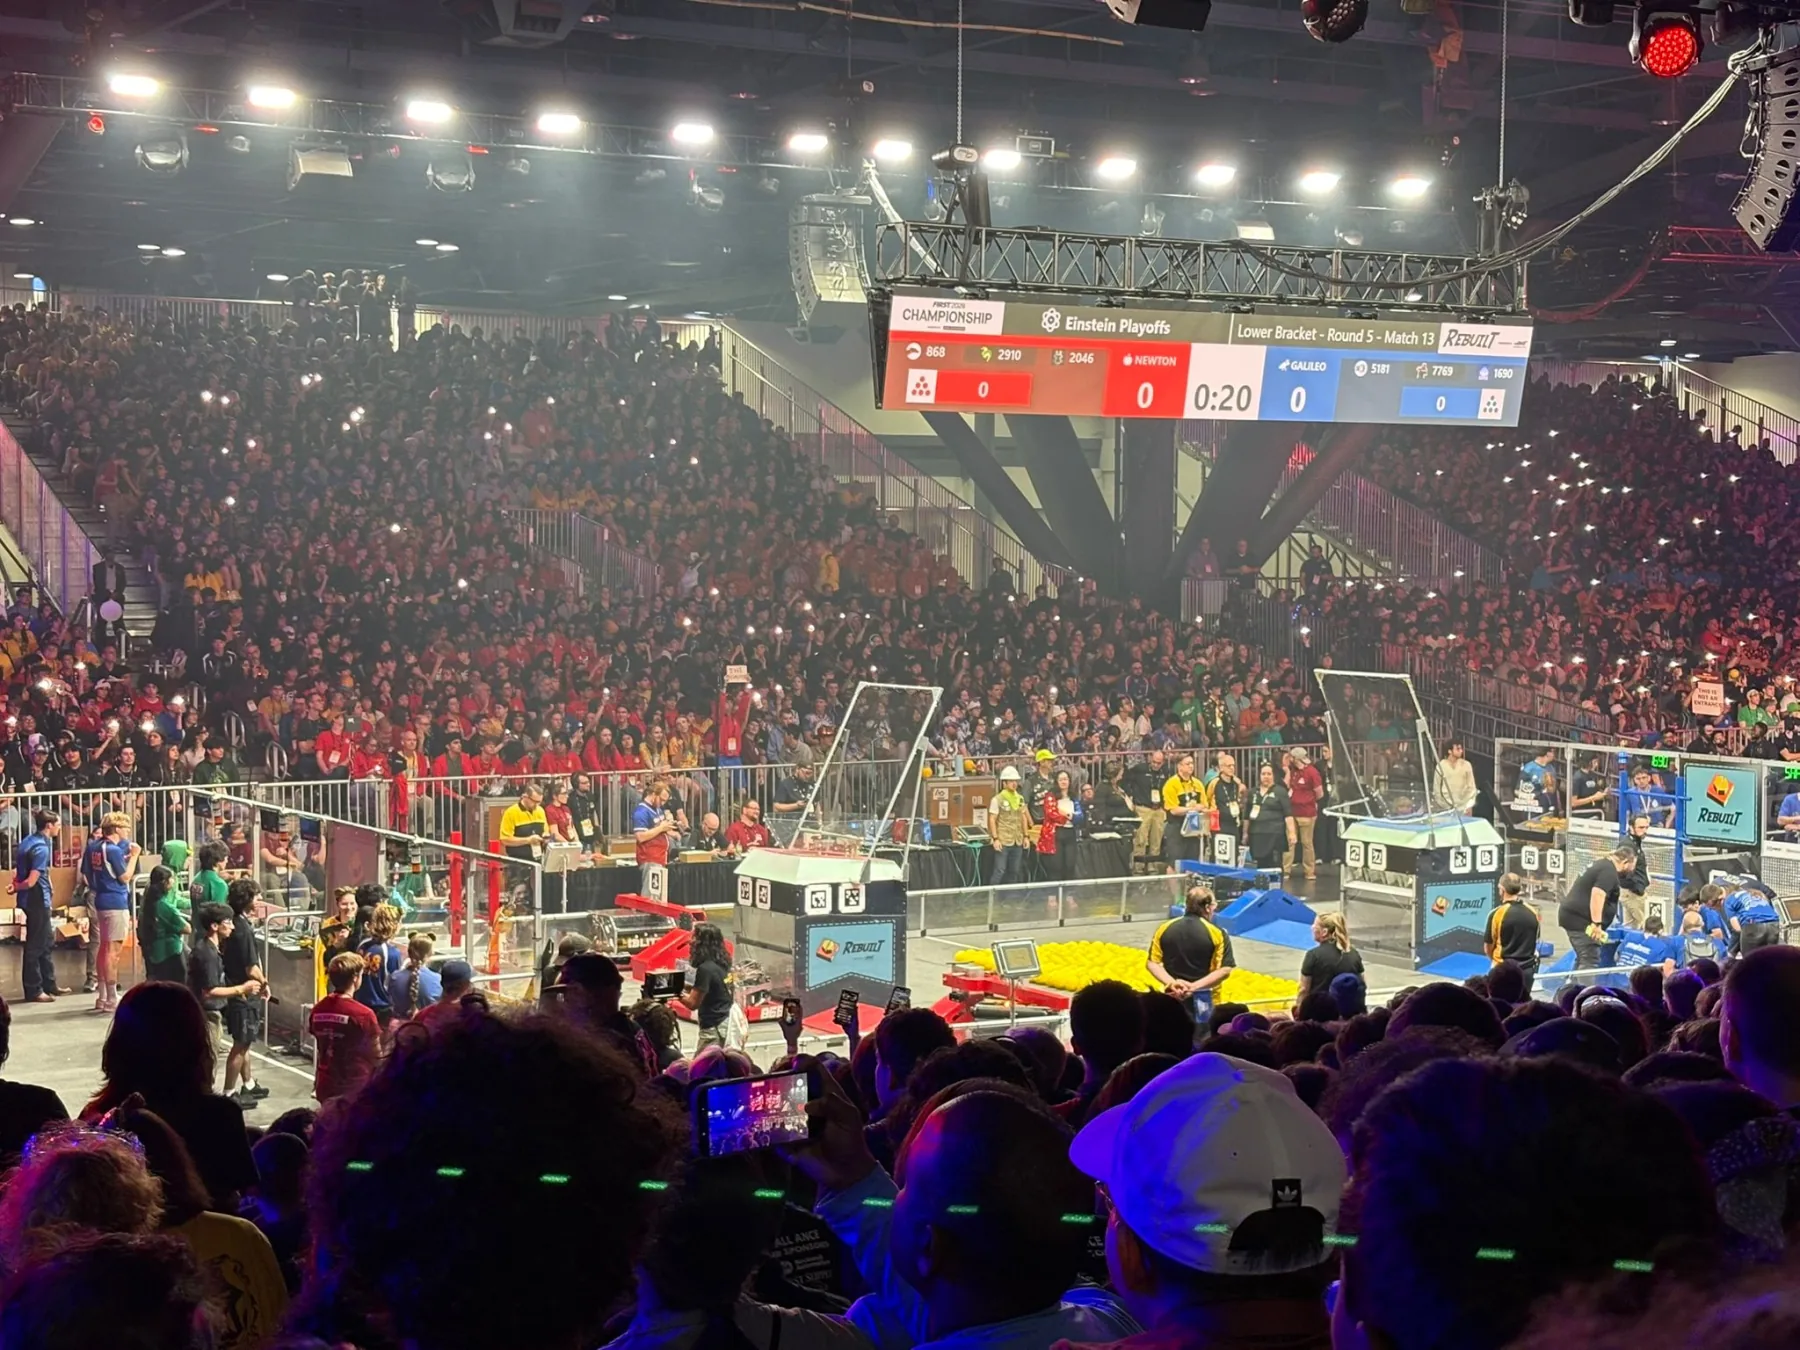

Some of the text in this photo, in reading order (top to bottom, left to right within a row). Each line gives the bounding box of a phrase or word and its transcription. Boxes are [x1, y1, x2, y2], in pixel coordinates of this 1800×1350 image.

[902, 308, 993, 324] CHAMPIONSHIP
[1065, 316, 1171, 337] Einstein Playoffs
[1237, 324, 1273, 339] Lower
[1275, 325, 1318, 341] Bracket
[1327, 328, 1365, 343] Round
[1366, 329, 1374, 342] 5
[1384, 330, 1418, 345] Match
[1422, 332, 1435, 346] 13
[1443, 329, 1500, 349] REBUILT
[926, 346, 946, 358] 868
[997, 349, 1022, 361] 2910
[1068, 352, 1094, 364] 2046
[1134, 355, 1177, 367] NEWTON
[1290, 361, 1327, 372] GALILEO
[1370, 363, 1390, 374] 5181
[1432, 365, 1454, 377] 7769
[1493, 368, 1514, 379] 1690
[978, 381, 989, 398] 0
[1137, 382, 1154, 409] 0
[1194, 383, 1252, 412] 0:20
[1290, 386, 1307, 413] 0
[1436, 395, 1446, 412] 0
[1697, 807, 1743, 827] REBUILT
[1452, 897, 1487, 910] REBUILT
[842, 940, 886, 955] REBUILT
[774, 1229, 821, 1248] ALLANCE
